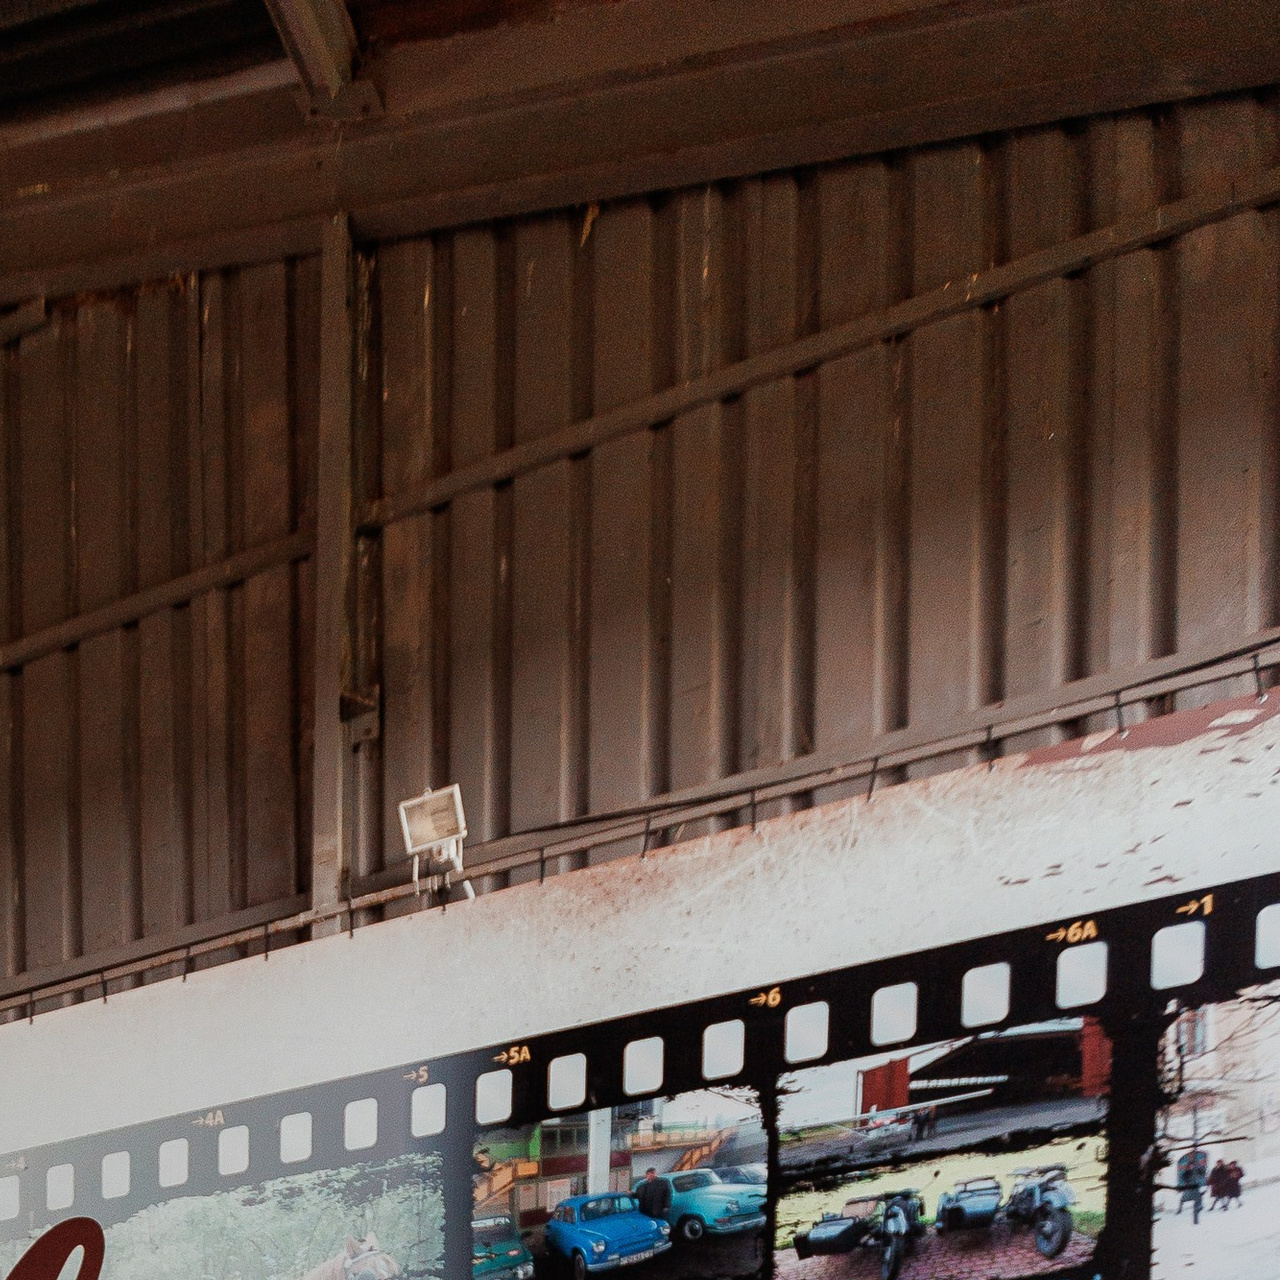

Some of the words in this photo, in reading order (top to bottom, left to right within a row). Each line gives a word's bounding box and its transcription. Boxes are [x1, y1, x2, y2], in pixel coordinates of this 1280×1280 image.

[1200, 893, 1215, 915] 1
[1067, 920, 1098, 943] 6A
[767, 987, 781, 1008] 6
[508, 1046, 531, 1065] 5A
[419, 1066, 429, 1085] 5
[206, 1109, 225, 1127] 4A
